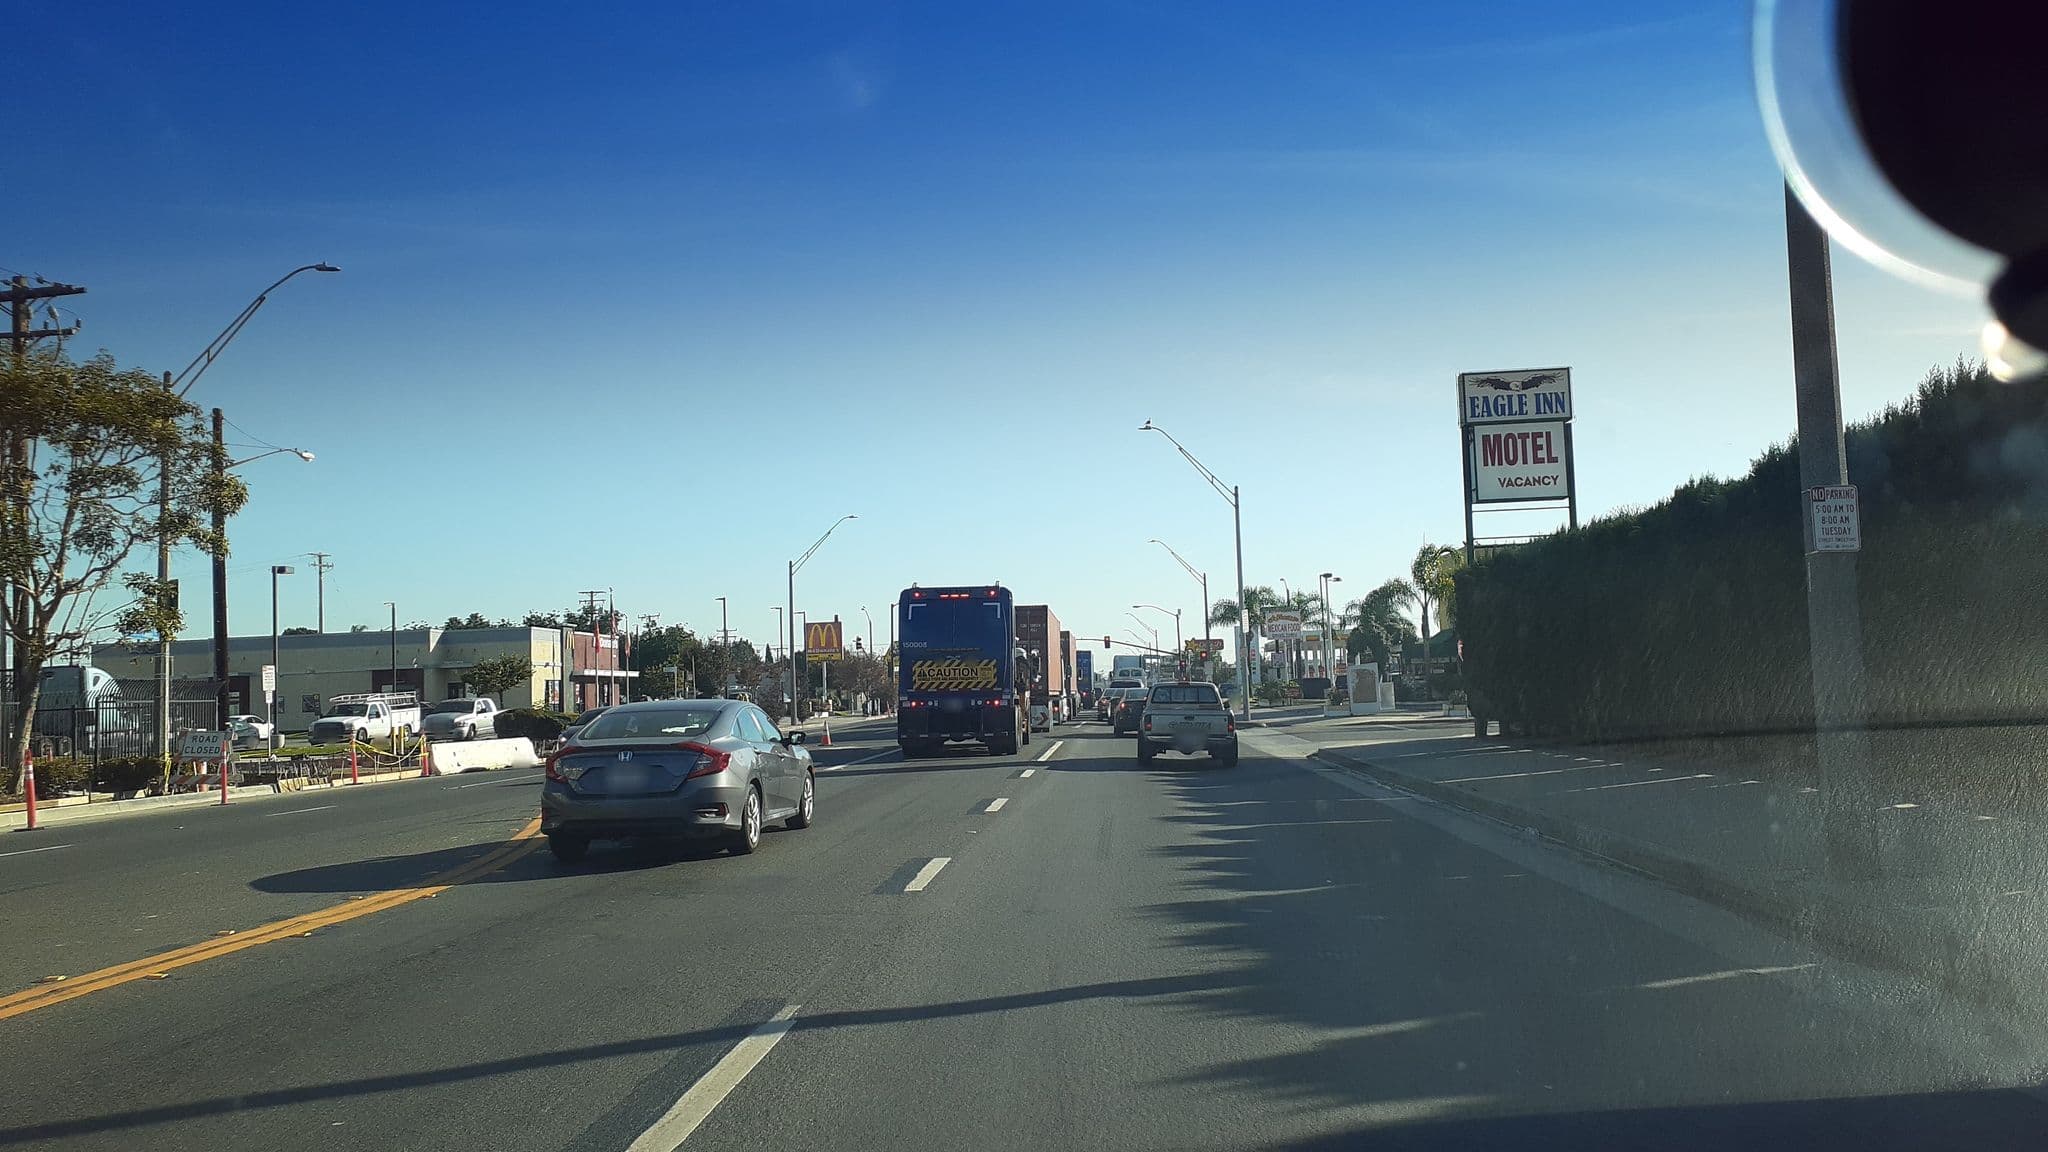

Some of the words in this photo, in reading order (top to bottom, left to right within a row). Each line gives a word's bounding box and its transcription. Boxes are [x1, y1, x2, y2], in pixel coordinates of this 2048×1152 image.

[1469, 393, 1528, 418] EAGLE
[1534, 391, 1566, 415] INN
[1481, 431, 1559, 467] MOTEL
[1498, 475, 1560, 488] VACANCY
[1812, 488, 1825, 501] NO
[1825, 488, 1856, 500] PARKING
[1833, 503, 1844, 513] AM
[1846, 503, 1855, 513] TO
[1839, 515, 1850, 524] AM
[1821, 526, 1851, 536] TUESDAY
[1288, 622, 1301, 633] FOOD
[927, 667, 979, 678] CAUTION
[191, 735, 218, 743] ROAD
[184, 745, 220, 754] CLOSED
